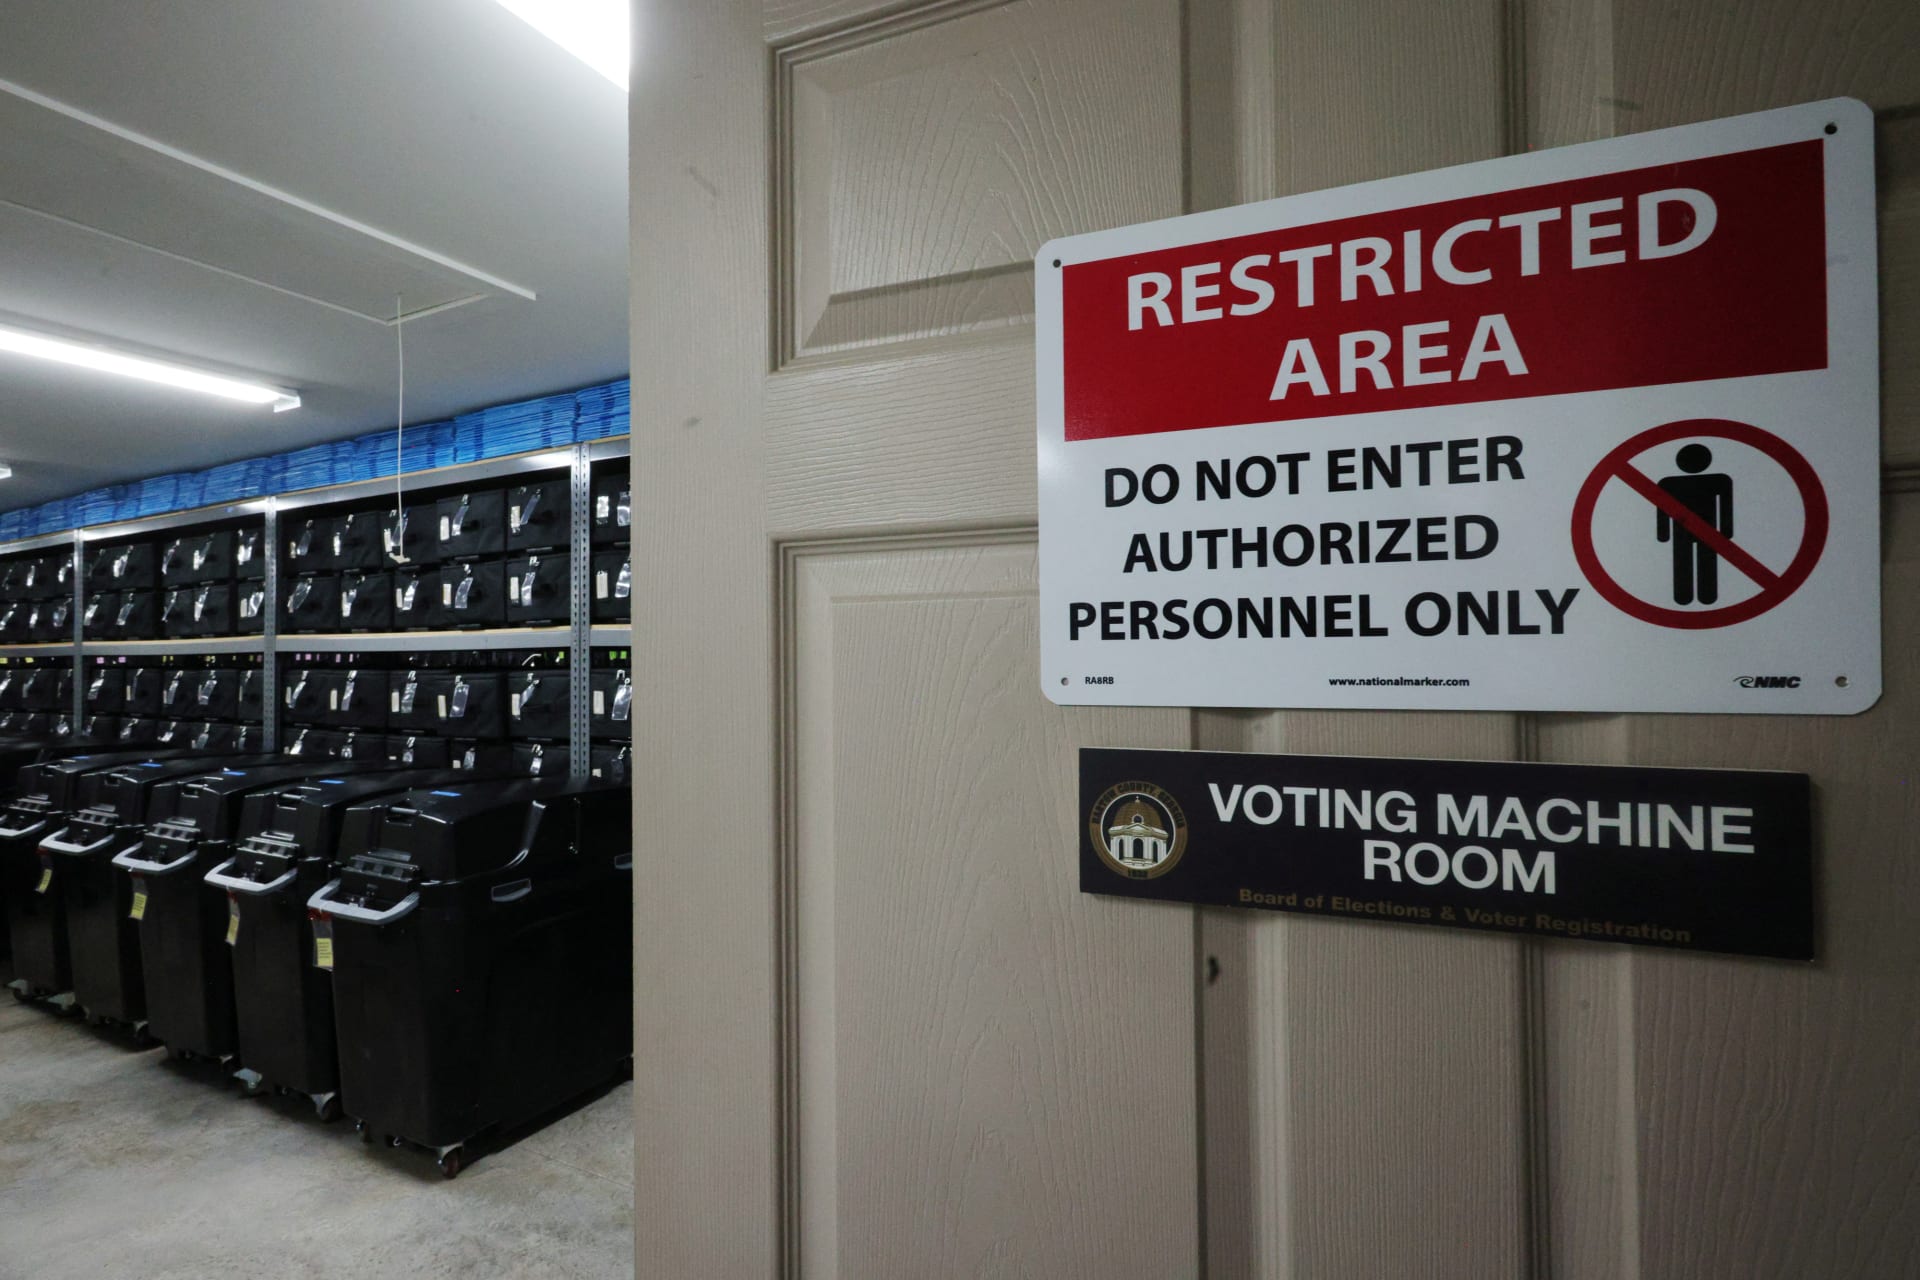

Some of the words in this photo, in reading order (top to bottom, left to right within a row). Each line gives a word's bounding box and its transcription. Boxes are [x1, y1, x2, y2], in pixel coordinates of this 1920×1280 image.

[1127, 187, 1718, 332] RESTRICTED
[1269, 313, 1529, 401] AREA
[1104, 463, 1180, 508] DO
[1196, 452, 1310, 501] NOT
[1327, 435, 1525, 493] ENTER
[1123, 514, 1499, 574] AUTHORIZED
[1069, 594, 1389, 641] PERSONNEL
[1405, 588, 1580, 636] ONLY
[1085, 676, 1114, 685] RA8RB
[1328, 675, 1470, 687] www.nationalmarker.com
[1754, 676, 1801, 688] NMC
[1208, 782, 1417, 833] VOTING
[1437, 793, 1755, 854] MACHINE
[1363, 839, 1557, 895] ROOM
[1239, 888, 1297, 907] Board
[1304, 894, 1325, 909] of
[1331, 896, 1432, 919] Elections
[1439, 905, 1456, 921] &
[1464, 907, 1528, 929] Voter
[1535, 914, 1691, 944] Registration
